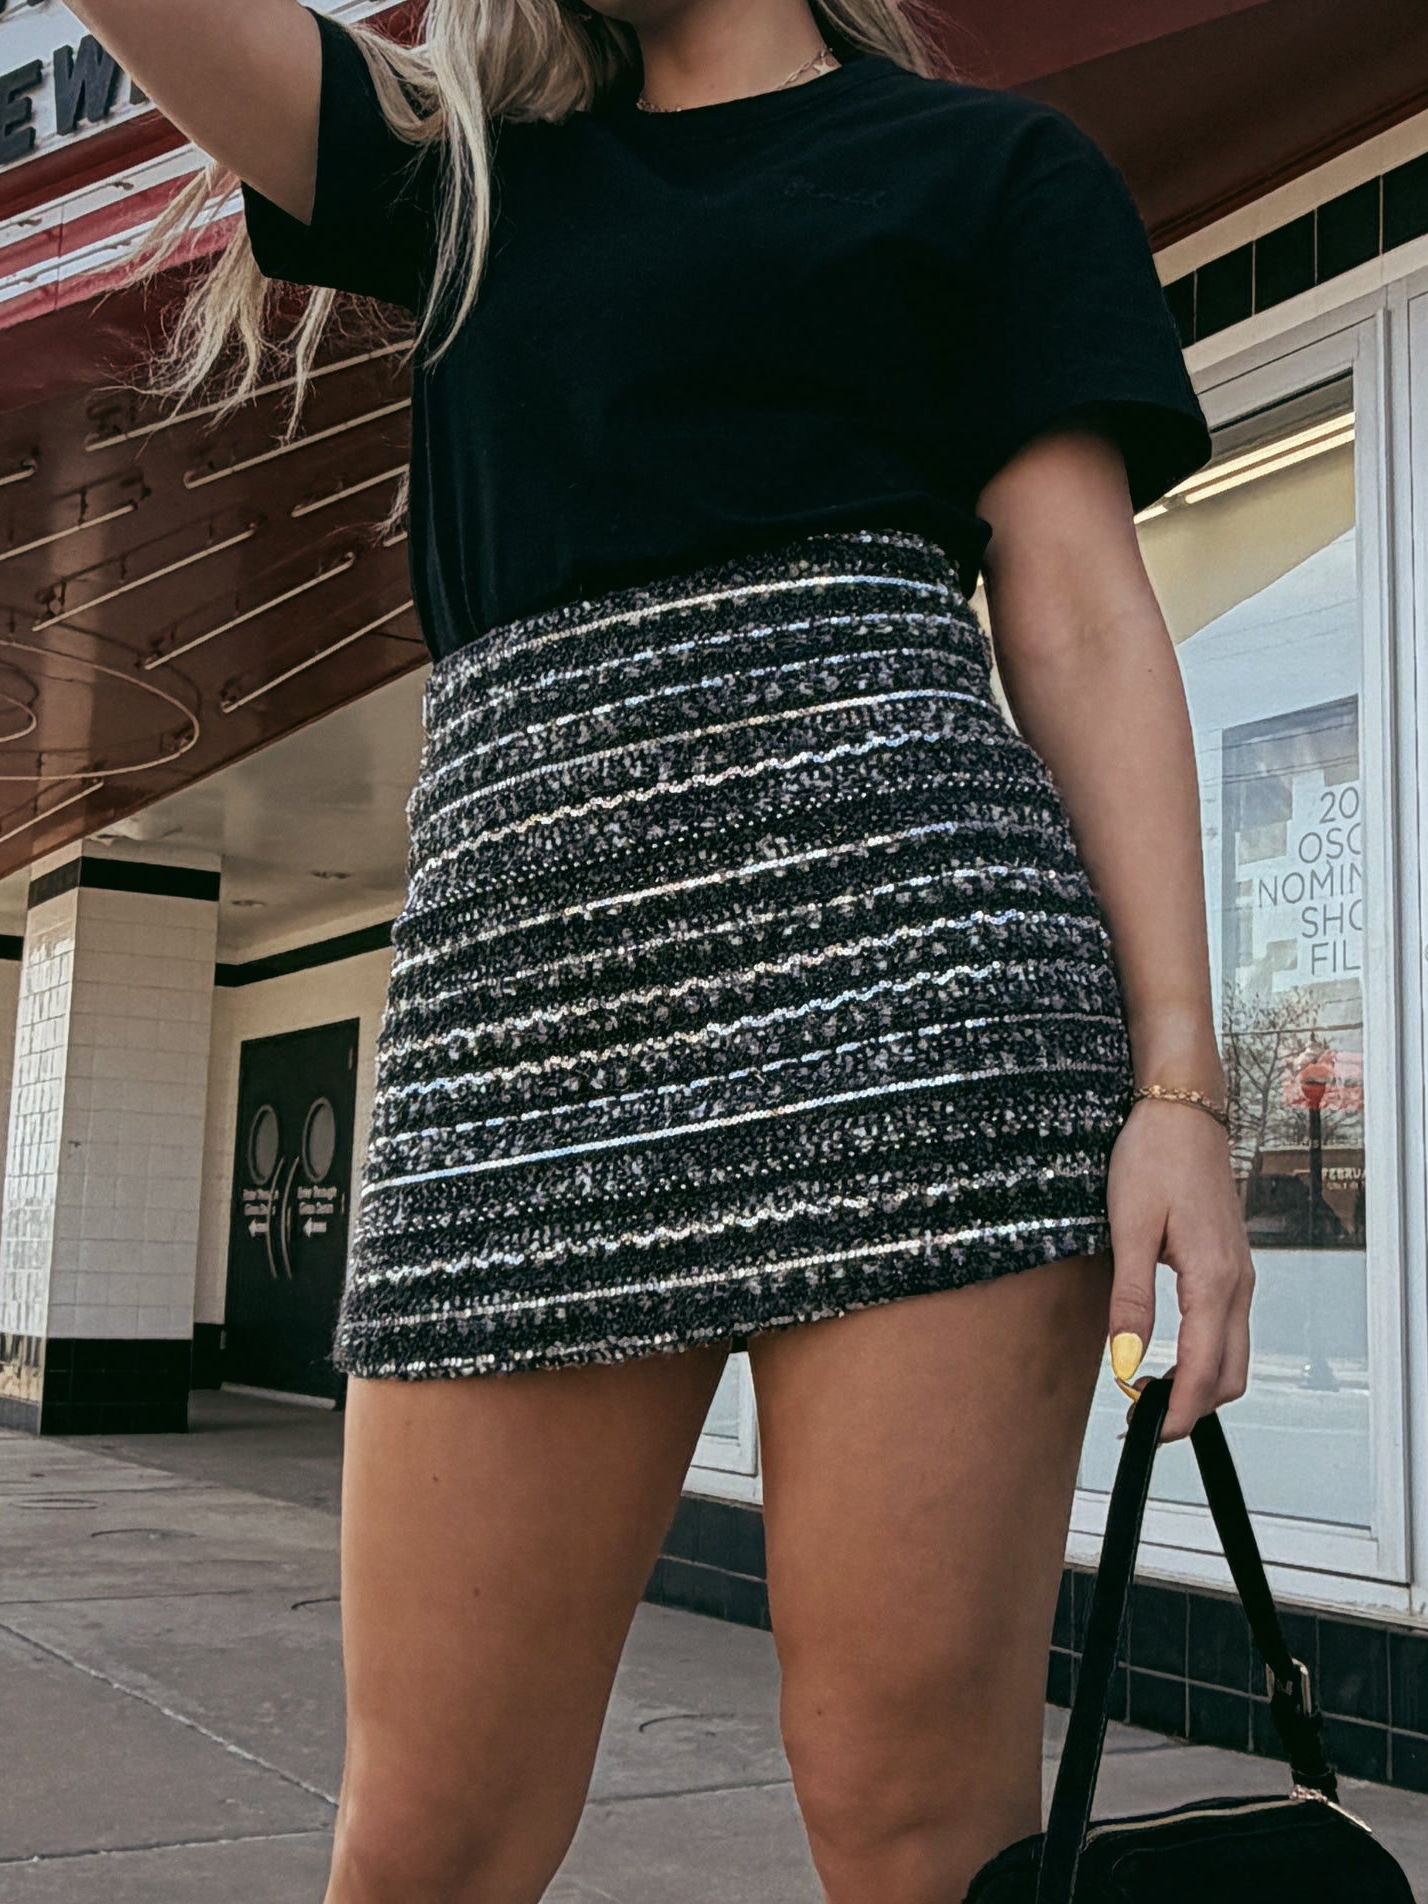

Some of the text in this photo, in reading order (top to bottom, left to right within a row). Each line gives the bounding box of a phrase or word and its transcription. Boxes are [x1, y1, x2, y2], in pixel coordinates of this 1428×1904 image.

[1319, 786, 1360, 824] 20
[1301, 899, 1362, 939] SHO
[1311, 940, 1361, 976] FIL
